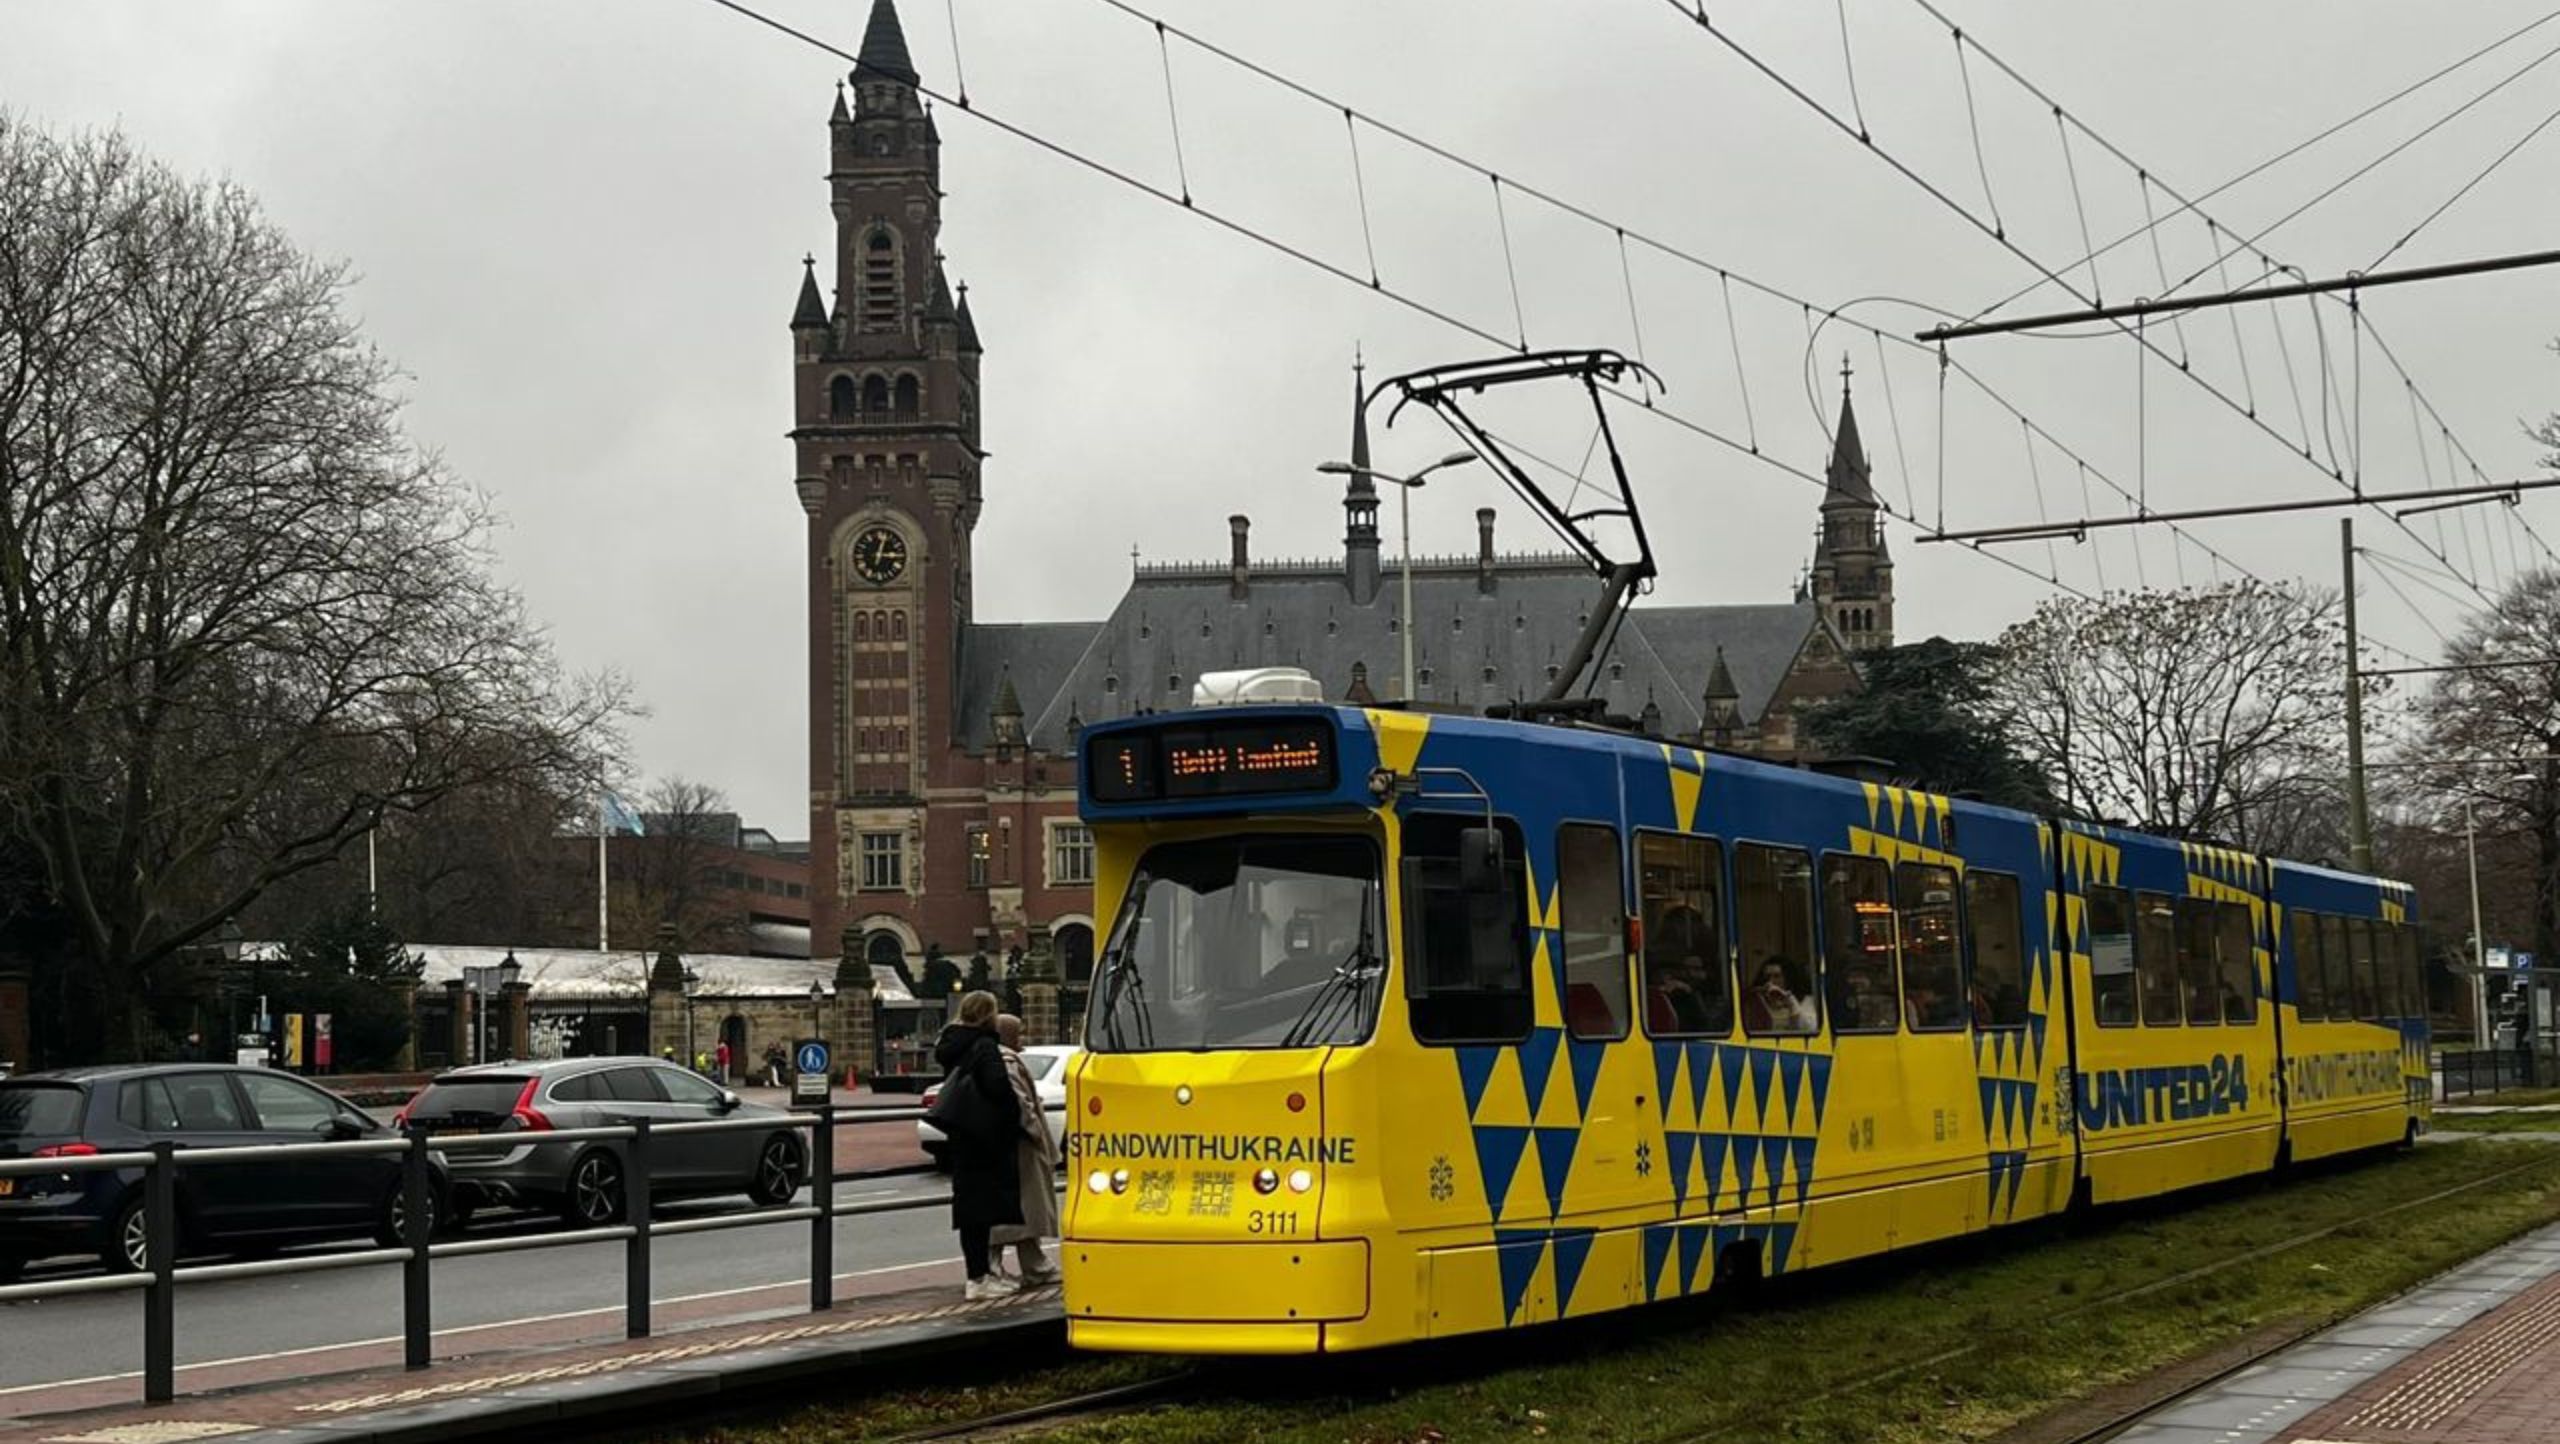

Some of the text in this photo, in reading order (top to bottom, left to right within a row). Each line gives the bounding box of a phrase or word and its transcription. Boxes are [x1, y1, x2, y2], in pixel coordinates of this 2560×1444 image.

[2517, 954, 2528, 969] P
[2077, 1053, 2248, 1132] UNITED24
[1069, 1132, 1356, 1164] STANDWITHUKRAINE
[1247, 1210, 1298, 1235] 3111
